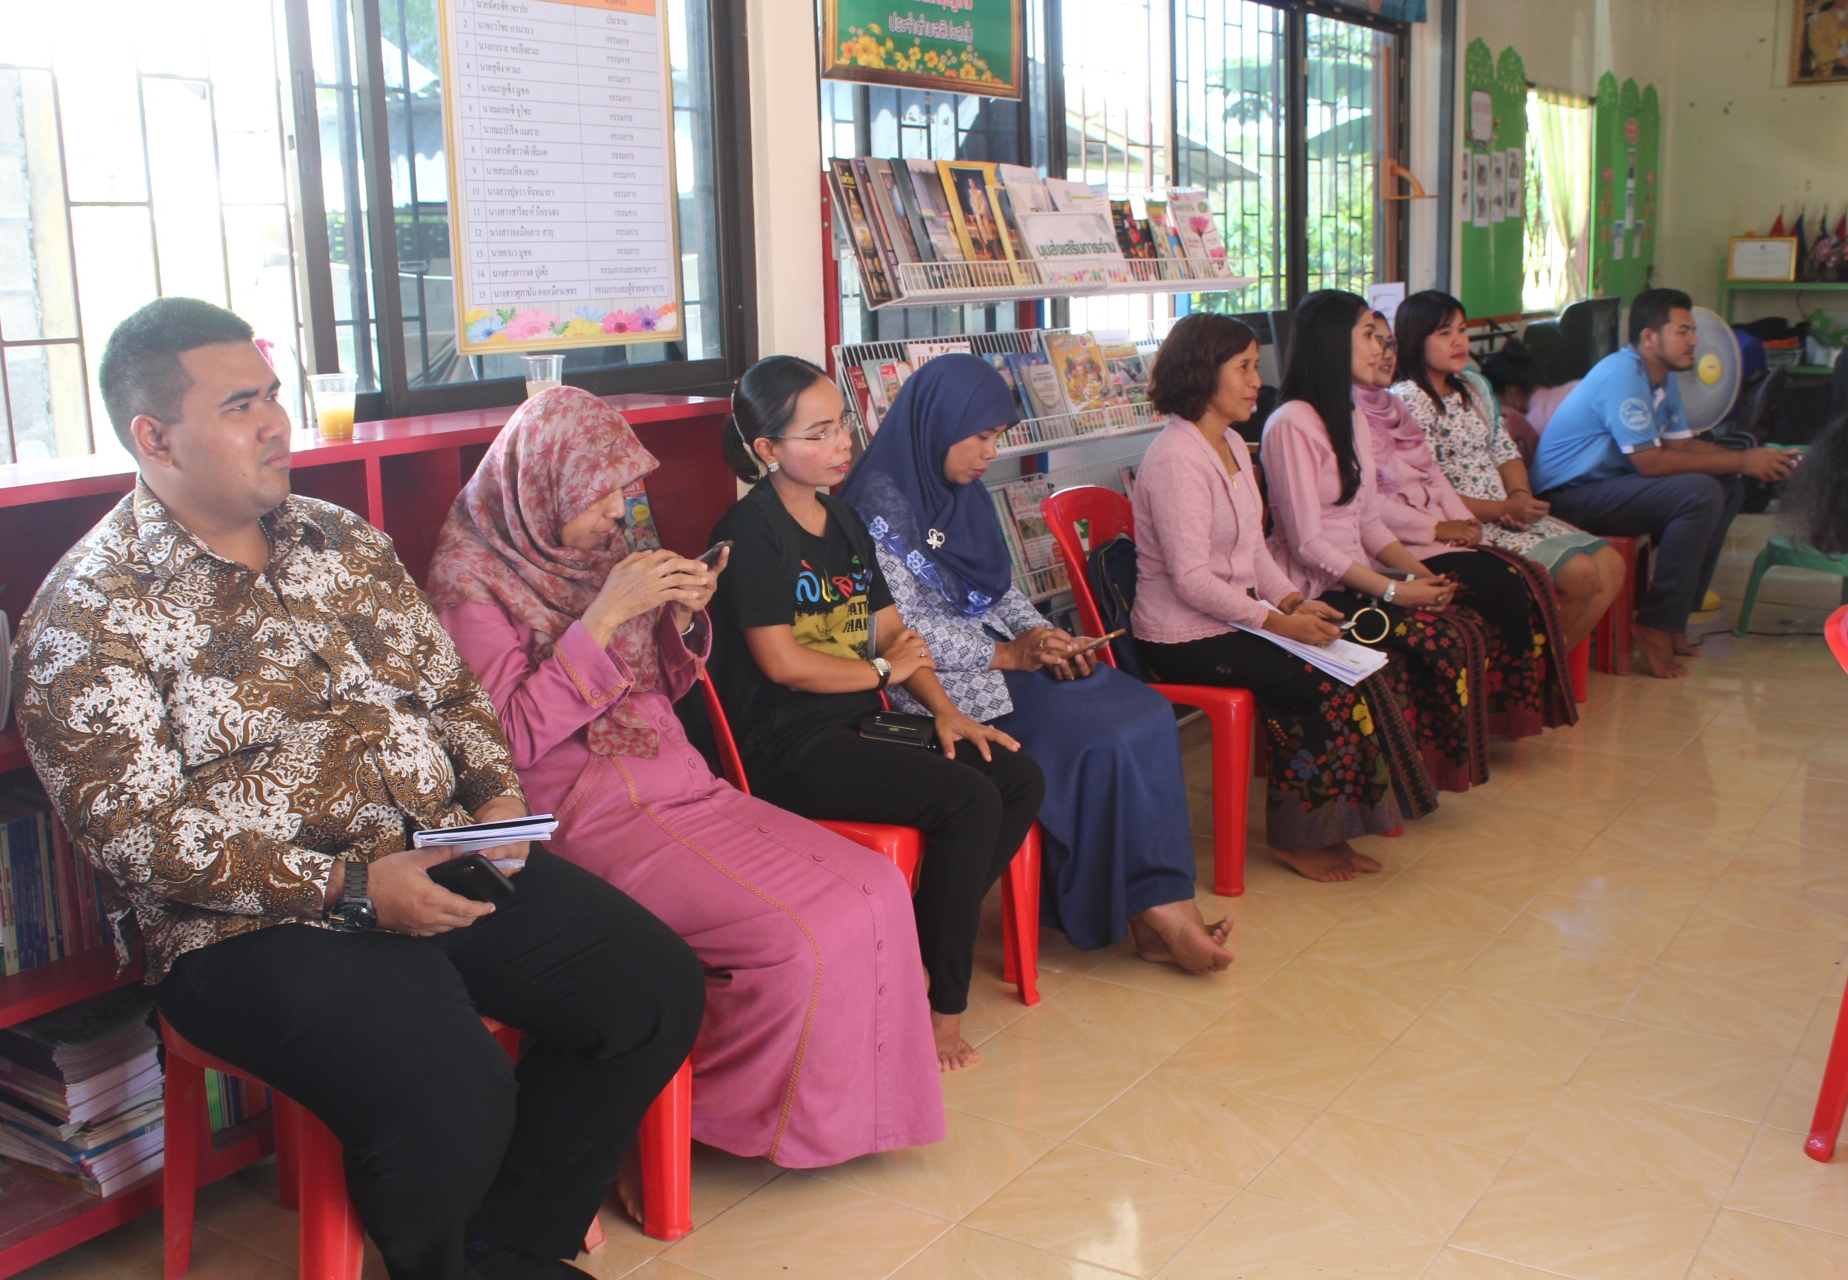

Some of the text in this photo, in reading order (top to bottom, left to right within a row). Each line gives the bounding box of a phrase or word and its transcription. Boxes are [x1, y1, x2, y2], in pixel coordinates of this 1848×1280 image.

[463, 19, 468, 28] 2
[606, 37, 629, 45] กรรมการ
[464, 40, 469, 49] 3
[607, 56, 629, 64] กรรมการ
[465, 61, 470, 70] 4
[467, 82, 471, 91] 5
[468, 104, 473, 112] 6
[469, 125, 474, 133] 7
[470, 146, 475, 154] 8
[472, 167, 477, 175] 9
[472, 187, 480, 195] 10
[473, 208, 480, 216] 11
[474, 229, 482, 237] 12
[1036, 237, 1118, 260] มุมส่งเสริมการอ่าน
[476, 249, 483, 258] 13
[477, 270, 485, 278] 14
[478, 290, 486, 299] 15
